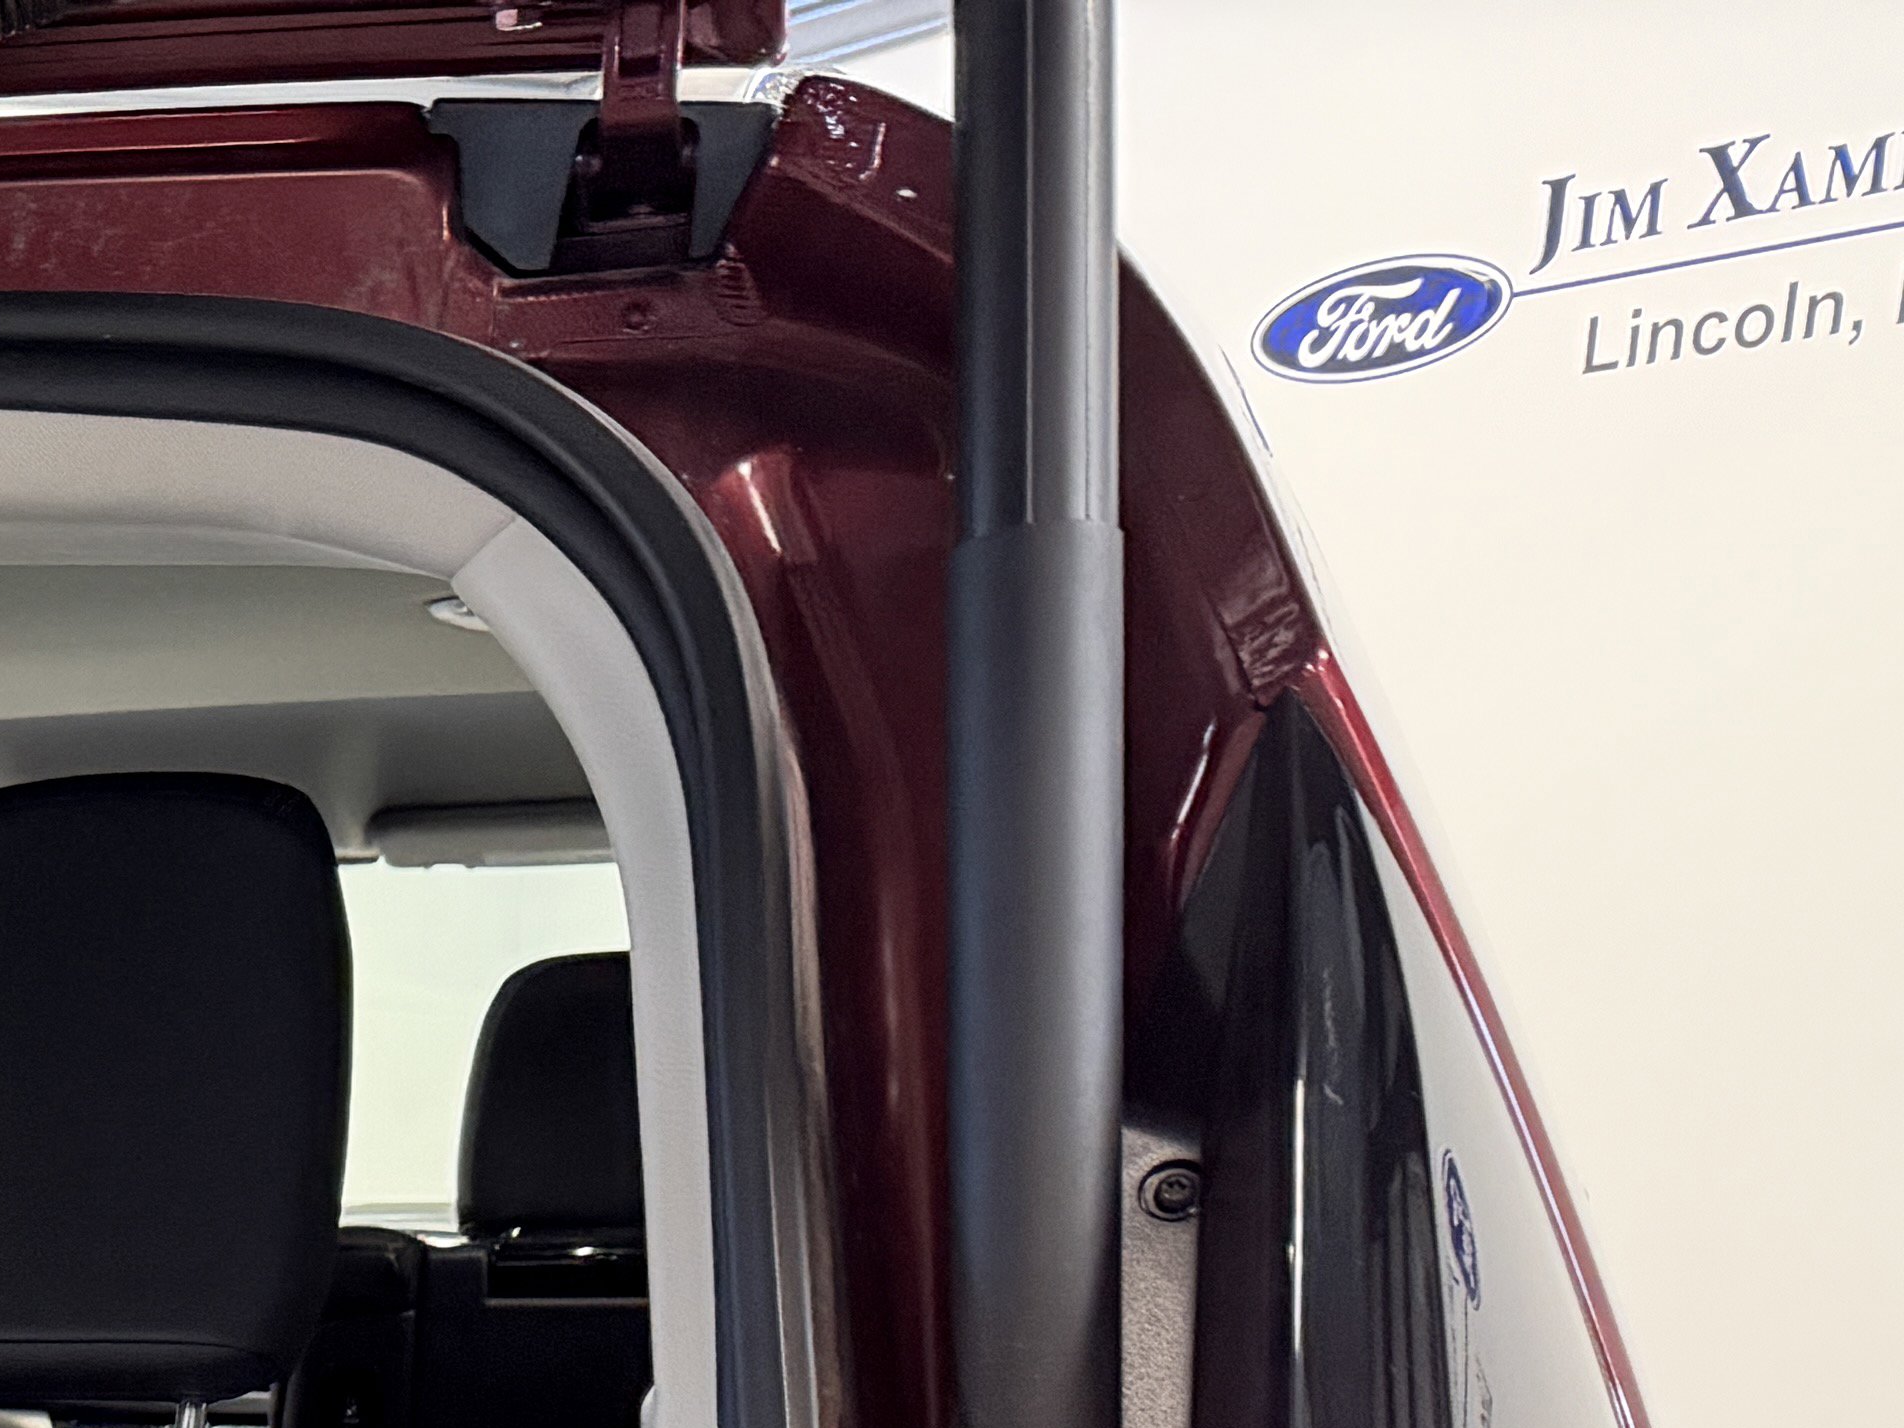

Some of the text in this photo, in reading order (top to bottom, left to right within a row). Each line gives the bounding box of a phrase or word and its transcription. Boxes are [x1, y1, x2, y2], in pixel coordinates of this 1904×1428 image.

[1529, 130, 1904, 275] JIM XAM
[1582, 281, 1864, 375] Lincoln,
